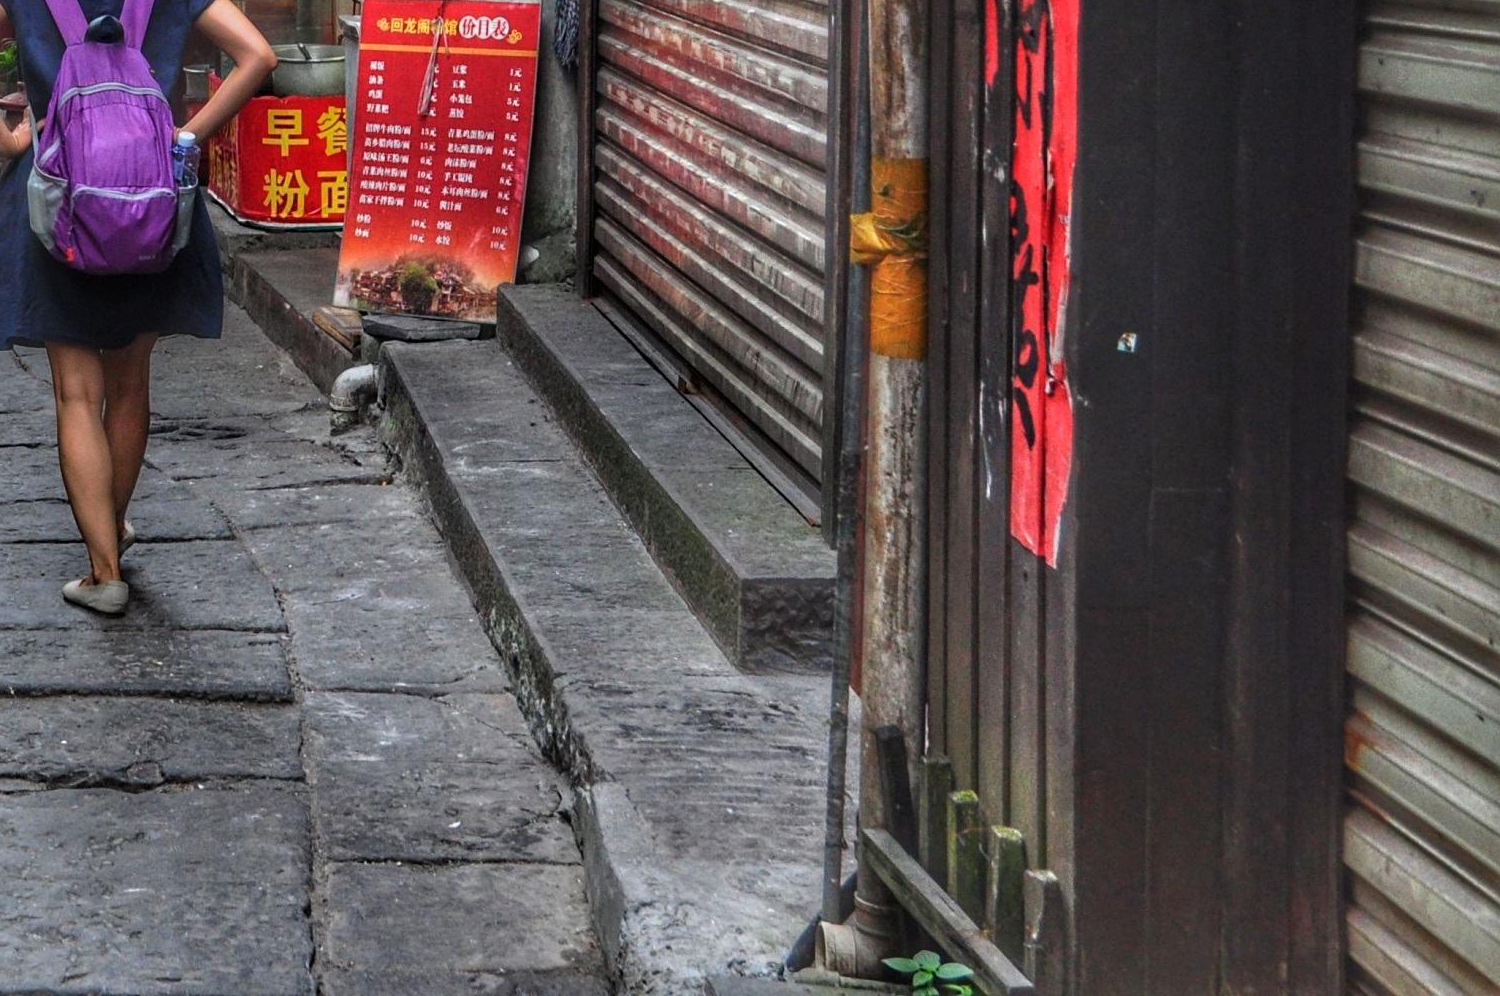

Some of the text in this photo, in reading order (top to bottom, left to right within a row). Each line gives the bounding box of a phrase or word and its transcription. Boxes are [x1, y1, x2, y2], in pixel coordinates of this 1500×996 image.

[461, 16, 508, 38] 价目表
[262, 106, 347, 157] 早餐
[263, 168, 347, 218] 粉面
